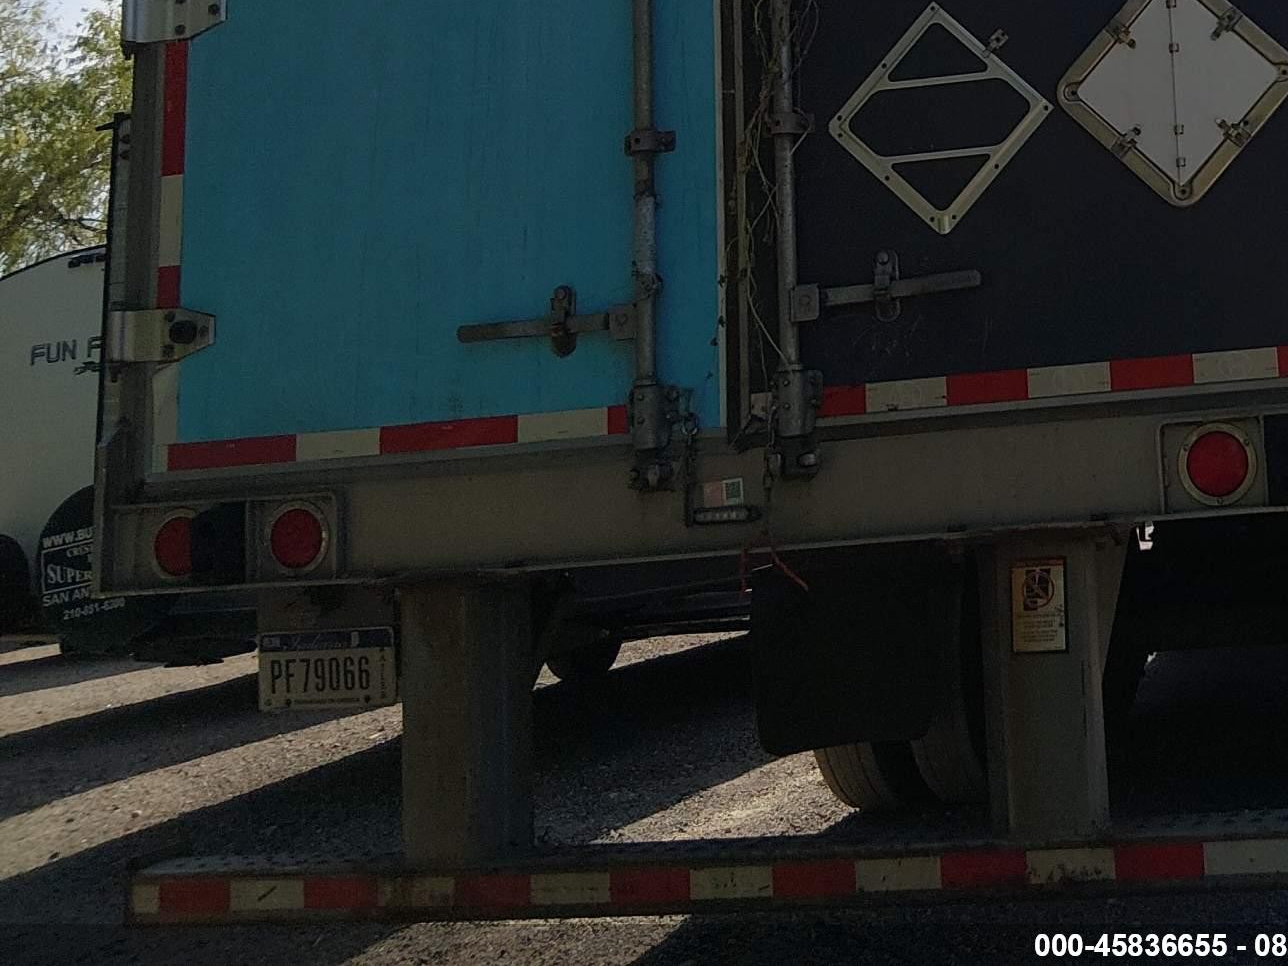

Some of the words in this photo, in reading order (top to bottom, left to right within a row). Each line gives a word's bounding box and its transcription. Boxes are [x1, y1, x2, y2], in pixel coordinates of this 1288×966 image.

[31, 339, 77, 366] FUN
[42, 591, 71, 607] SAN
[270, 655, 370, 694] PF79066
